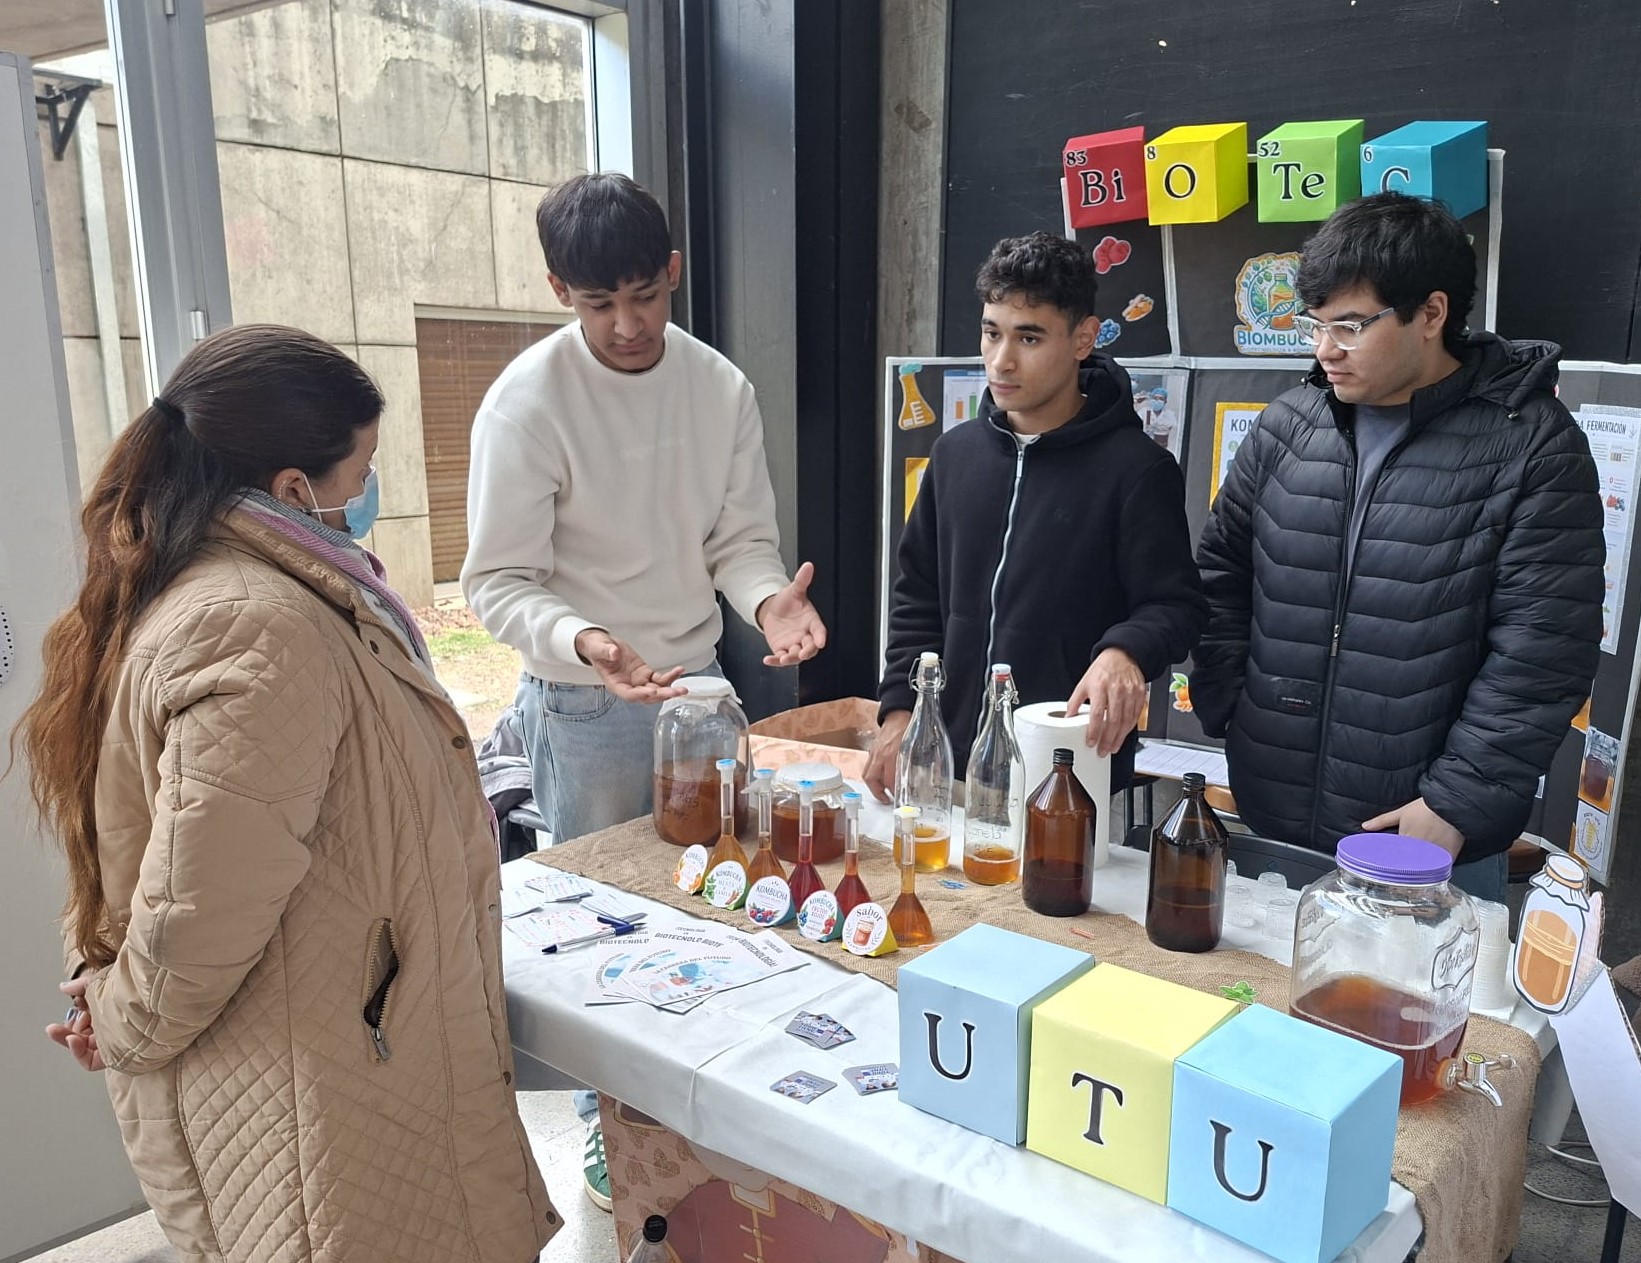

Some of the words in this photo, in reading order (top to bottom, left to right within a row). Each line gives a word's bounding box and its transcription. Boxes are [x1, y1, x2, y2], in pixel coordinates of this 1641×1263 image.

[1147, 146, 1156, 160] 8
[1259, 142, 1281, 157] 52
[1363, 146, 1373, 162] 6
[1066, 151, 1087, 166] 83
[1080, 169, 1125, 206] Bi
[1164, 164, 1196, 198] O
[1272, 163, 1325, 200] Te
[1237, 330, 1311, 346] BIOMBUC
[1587, 419, 1627, 435] FERMENTACIÓN
[755, 884, 788, 901] KOMBUCHA
[809, 898, 835, 912] KOMBUCHA
[856, 905, 884, 922] sabor
[924, 1012, 975, 1081] U
[1072, 1072, 1124, 1145] T
[1210, 1119, 1274, 1202] U
